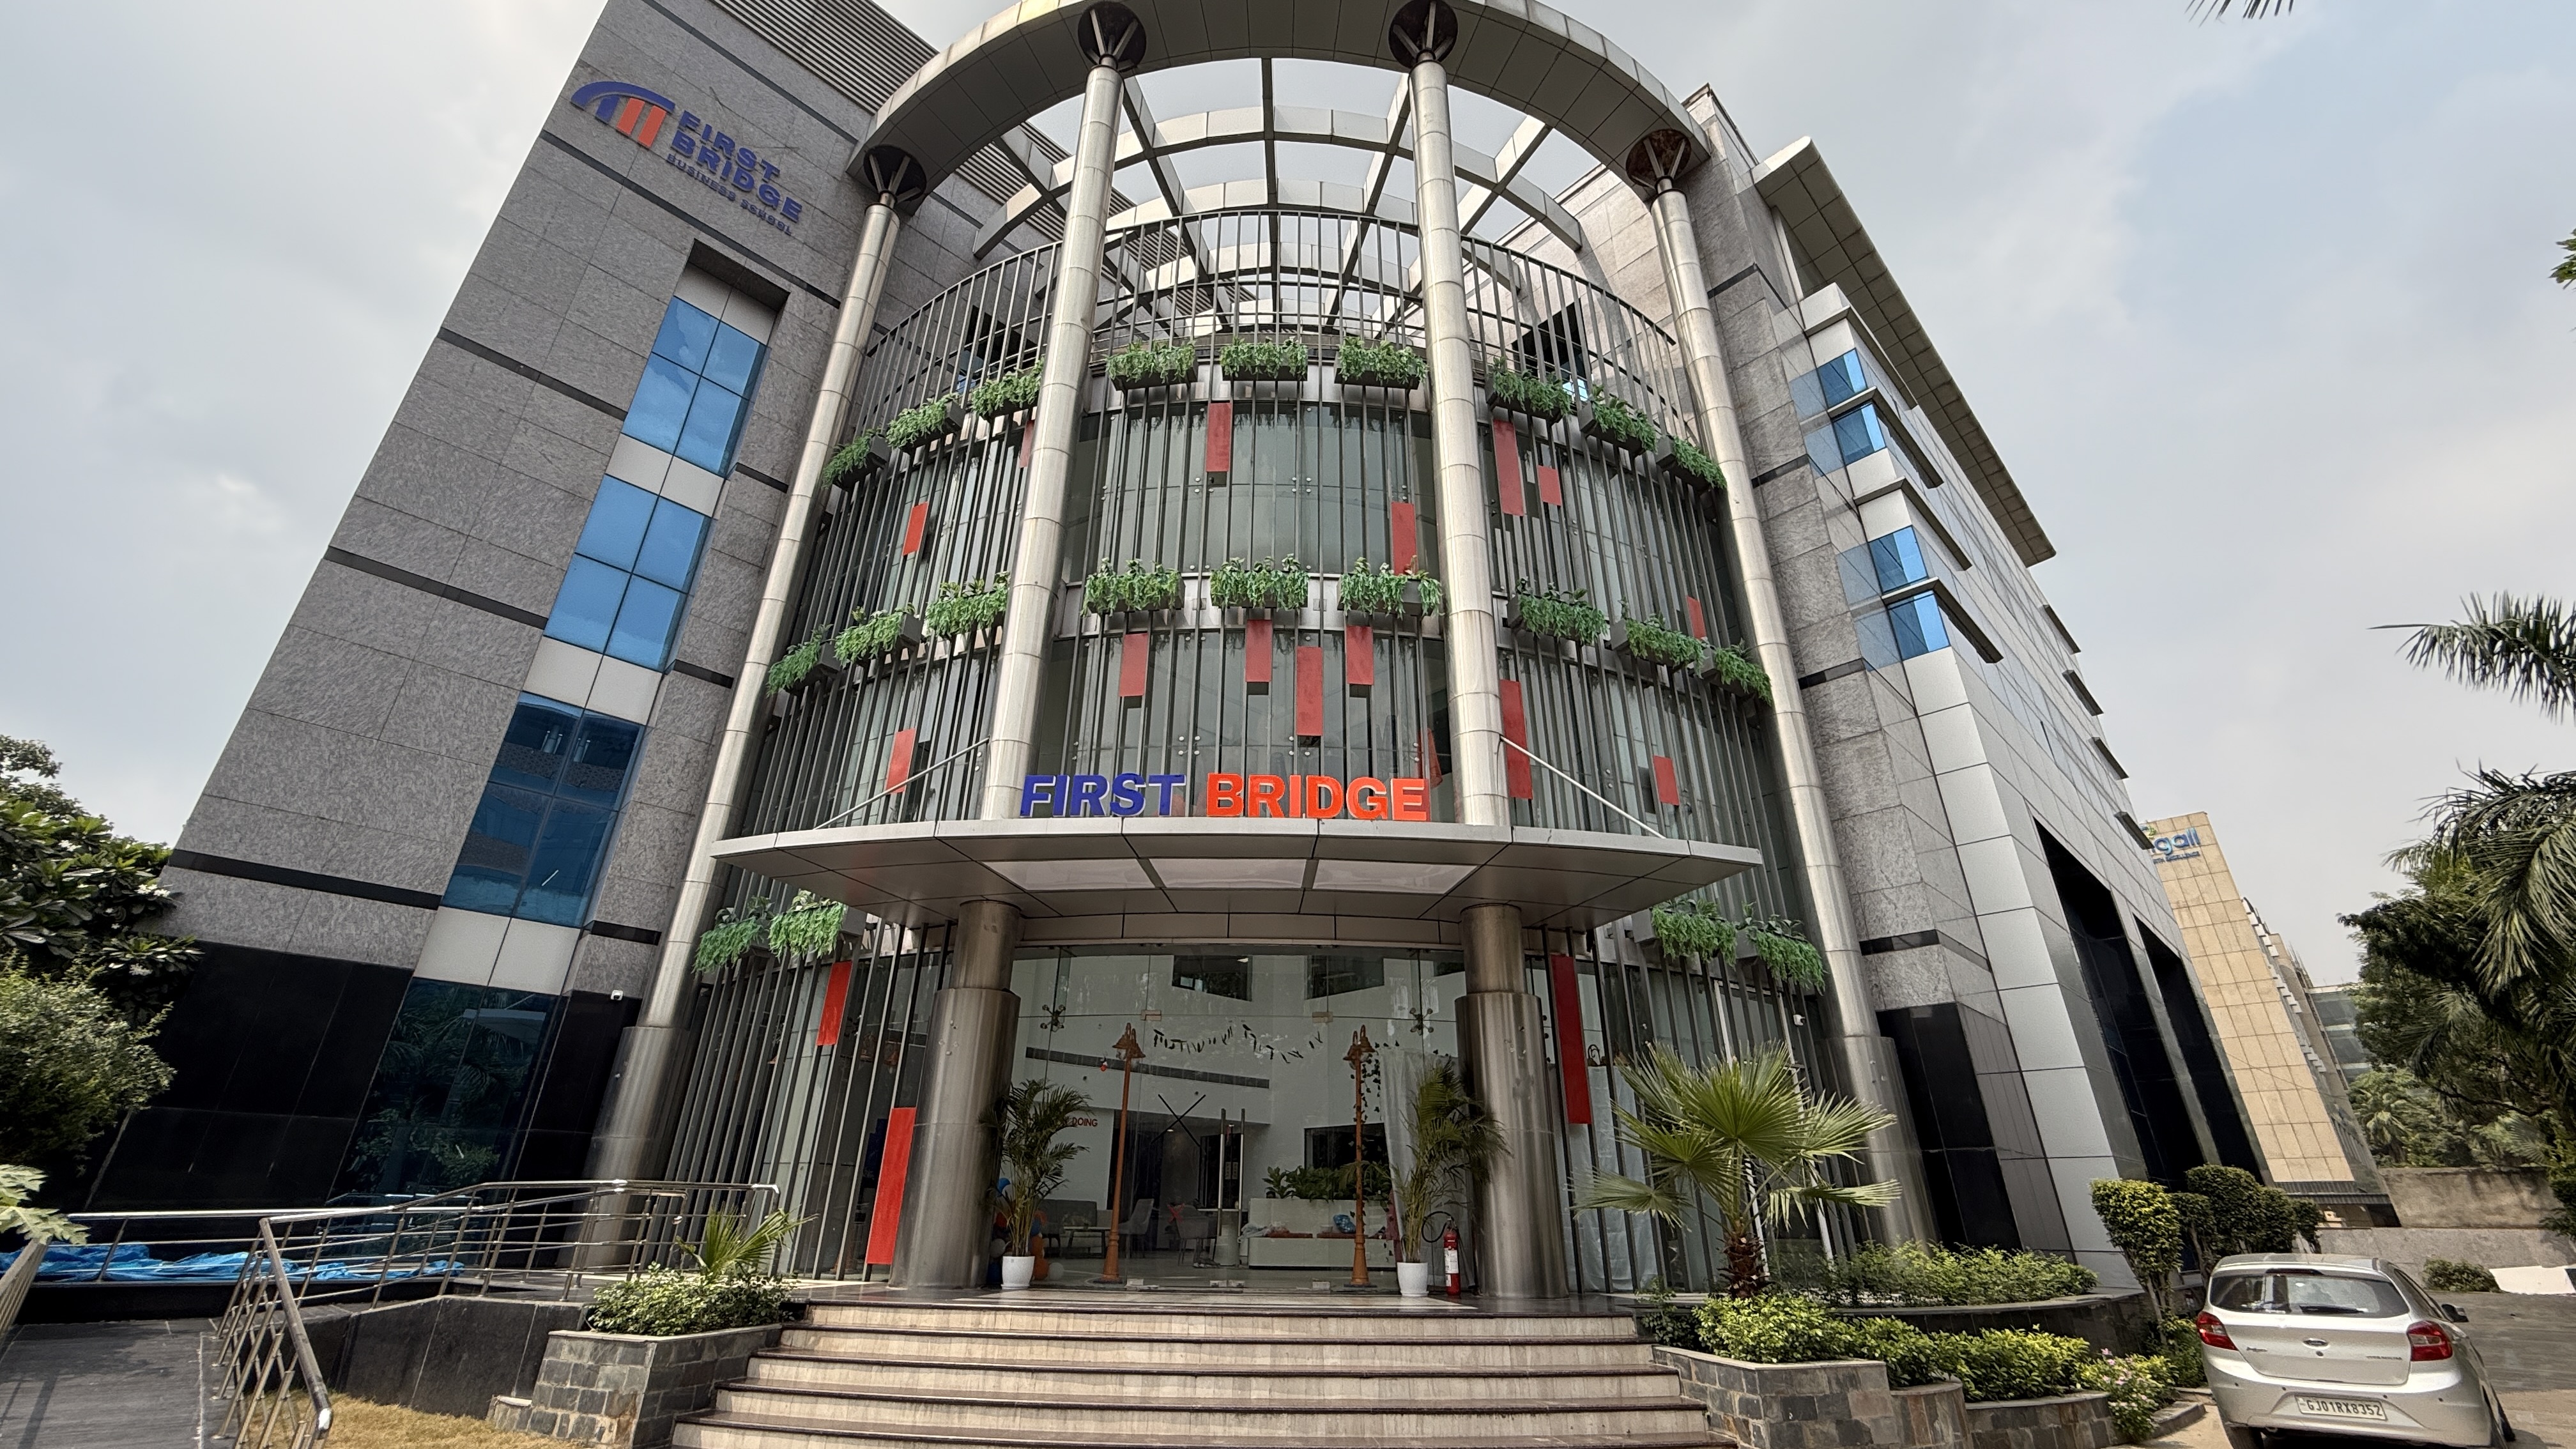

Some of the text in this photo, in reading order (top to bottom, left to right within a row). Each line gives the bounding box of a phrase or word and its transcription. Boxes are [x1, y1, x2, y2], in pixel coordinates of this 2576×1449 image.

[671, 130, 802, 224] BRIDGE
[678, 110, 780, 183] FIRST
[666, 153, 792, 236] BUSINESS SCHOOL
[1020, 772, 1431, 822] FIRST BRIDGE
[1072, 1117, 1098, 1127] DOING
[2306, 1399, 2383, 1416] GJ01RX8352
